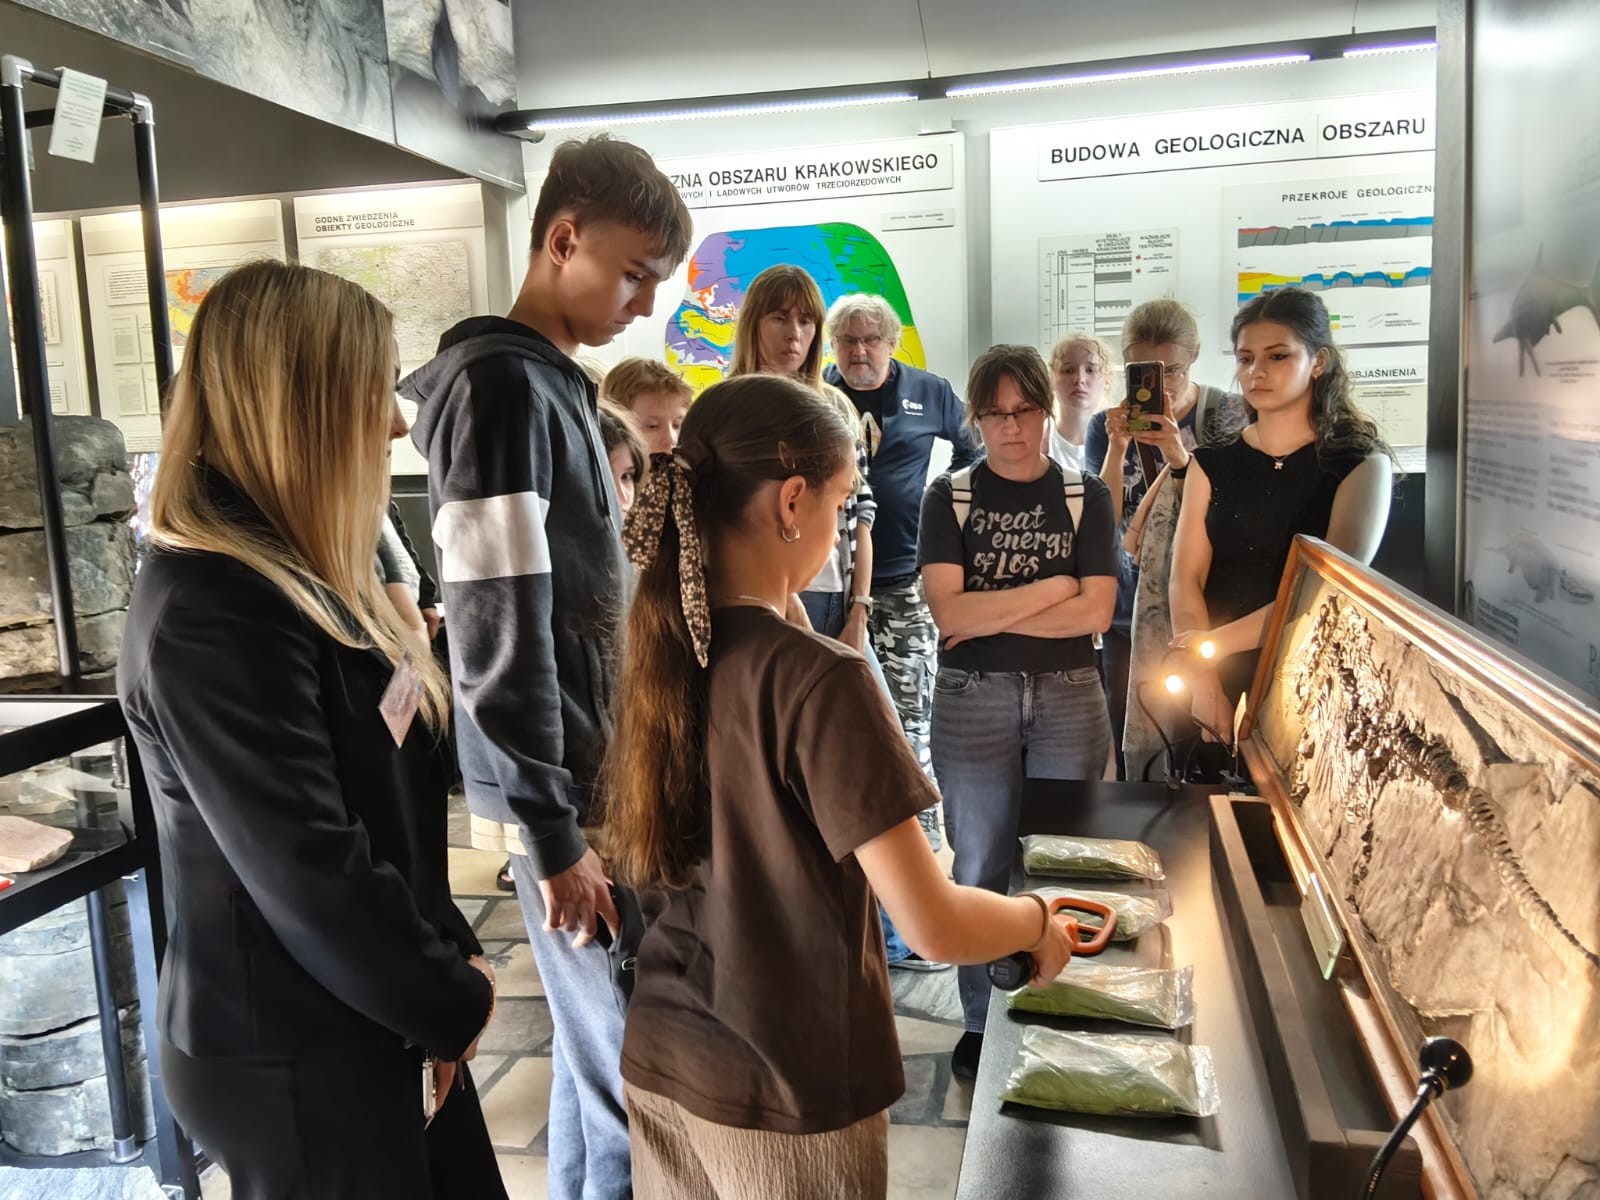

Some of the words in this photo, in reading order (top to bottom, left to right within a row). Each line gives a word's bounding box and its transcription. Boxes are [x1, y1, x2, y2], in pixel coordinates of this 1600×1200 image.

[1051, 141, 1141, 164] BUDOWA
[1154, 127, 1305, 155] GEOLOGICZNA
[1322, 117, 1426, 141] OBSZARU
[669, 172, 703, 189] ZNA
[708, 166, 787, 186] OBSZARU
[795, 153, 938, 180] KRAKOWSKIEGO
[681, 191, 703, 200] WYCH
[1281, 190, 1349, 203] PRZEKROJE
[1356, 184, 1435, 199] GEOLOGICZN
[314, 215, 345, 225] GODNE
[346, 211, 399, 222] ZWIEDZENIA
[315, 223, 352, 233] OBIEKTY
[354, 218, 415, 230] GEOLOGICZNE
[970, 503, 1047, 535] Great
[991, 531, 1073, 560] energy
[973, 551, 996, 574] of
